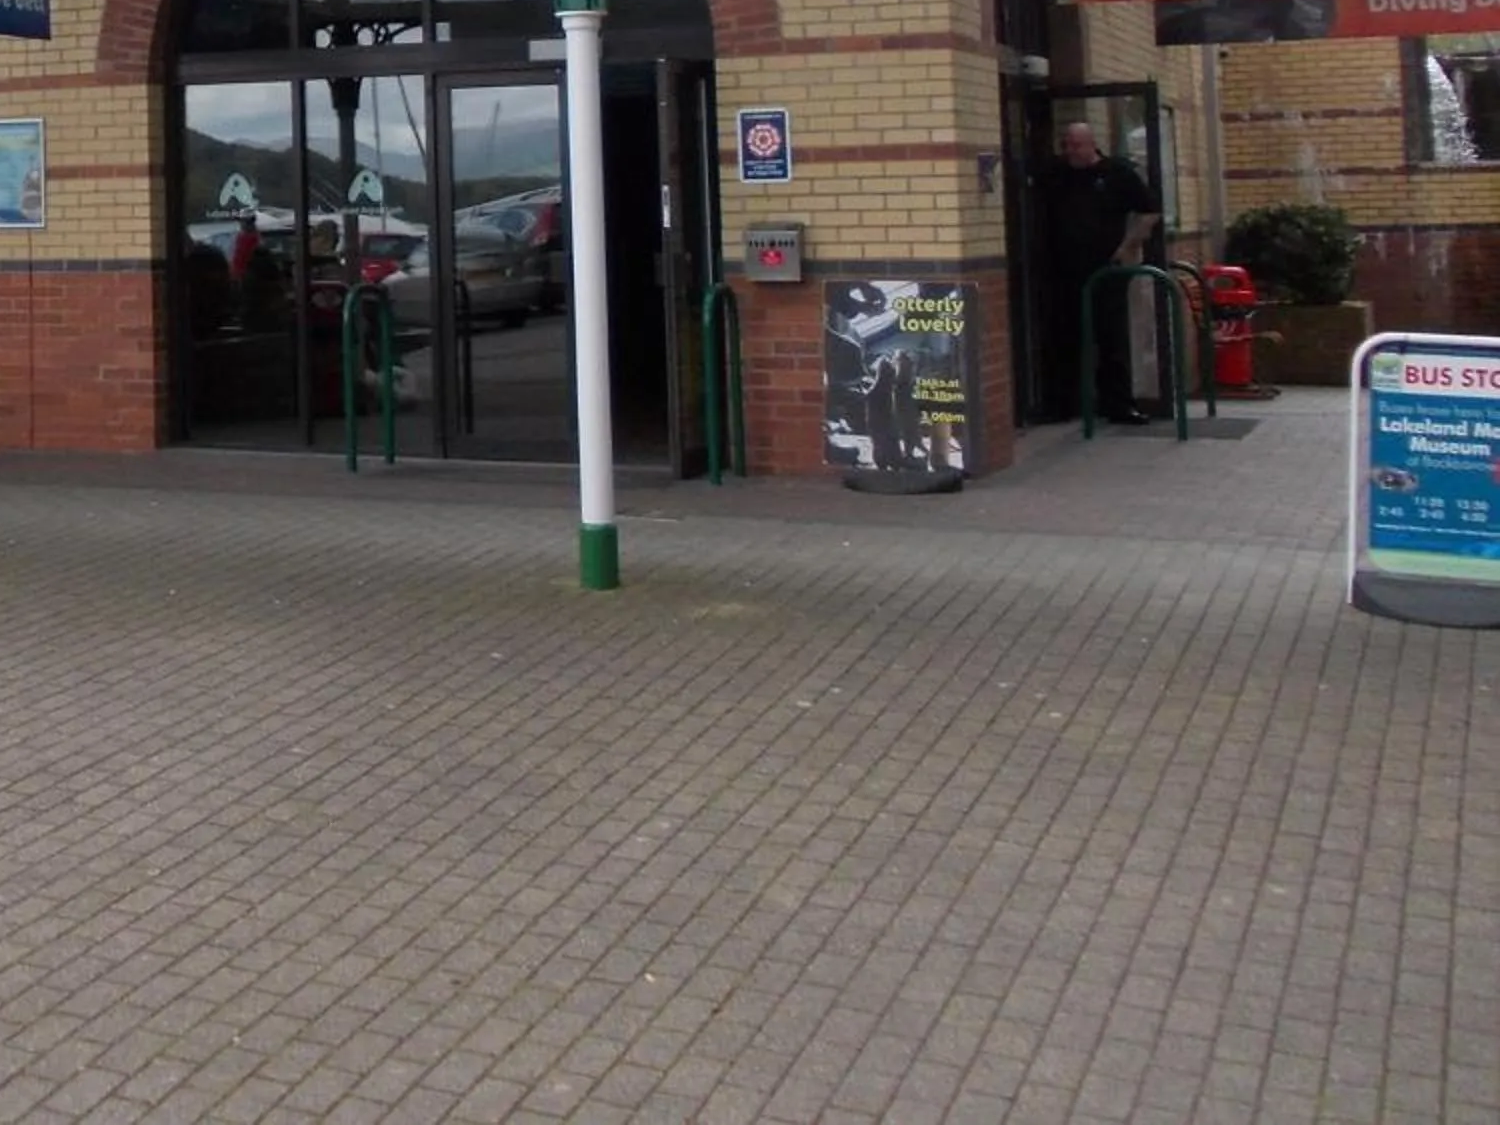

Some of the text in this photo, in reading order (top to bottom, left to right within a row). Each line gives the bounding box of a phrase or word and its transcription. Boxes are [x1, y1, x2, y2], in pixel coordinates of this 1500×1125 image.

[893, 296, 964, 315] otterly
[900, 315, 964, 336] lovely
[1405, 364, 1453, 386] BUS
[1380, 416, 1468, 436] Lakeland
[1410, 435, 1492, 456] Museum
